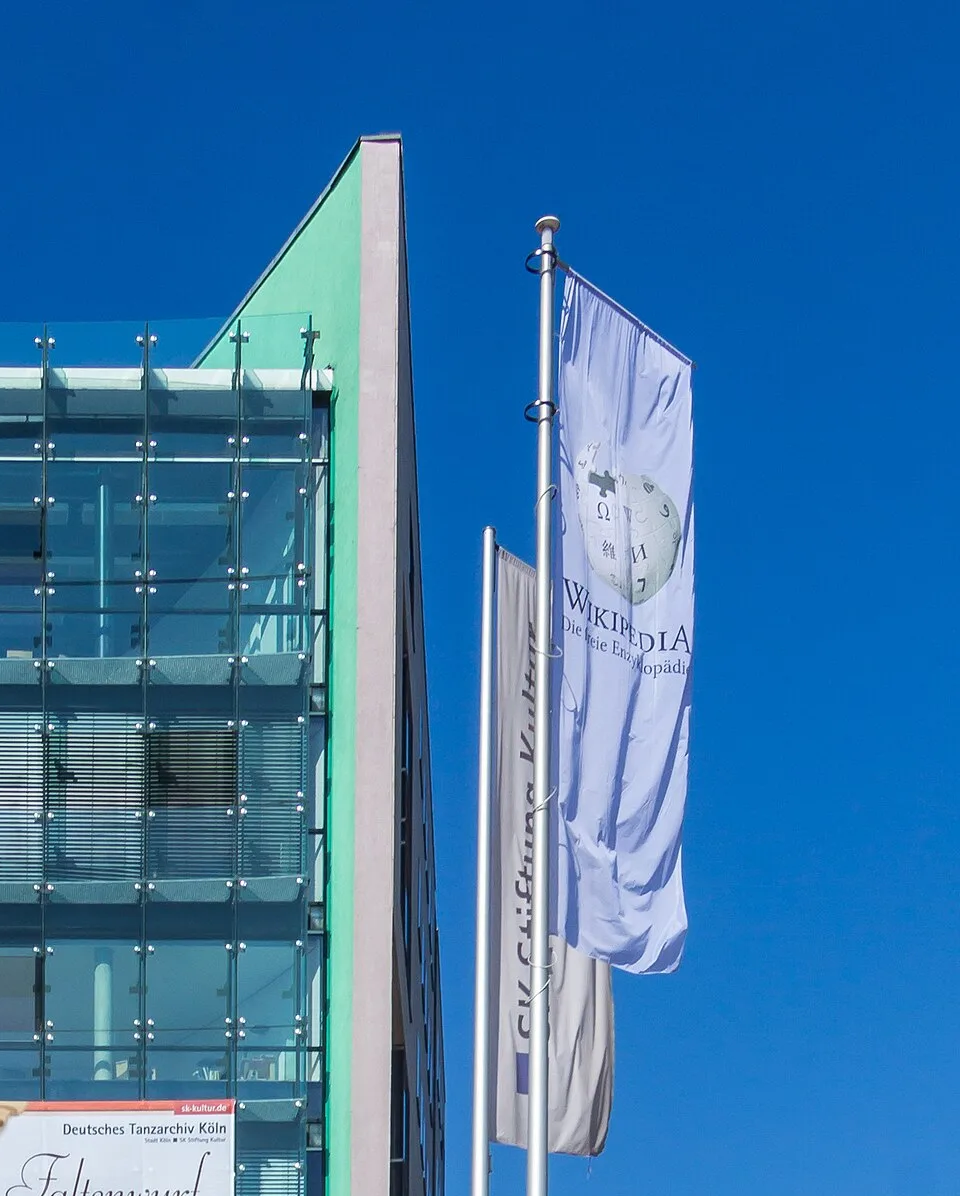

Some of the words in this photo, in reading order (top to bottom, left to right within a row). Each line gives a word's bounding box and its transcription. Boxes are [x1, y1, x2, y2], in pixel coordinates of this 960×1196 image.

[562, 576, 692, 655] WIKIPEDIA
[560, 614, 582, 637] Die
[612, 639, 690, 679] Enzyklopädi
[63, 1122, 125, 1136] Deutsches
[129, 1121, 195, 1136] Tanzarchiv
[199, 1120, 227, 1135] Köln
[181, 1104, 227, 1114] sk-kultur.de
